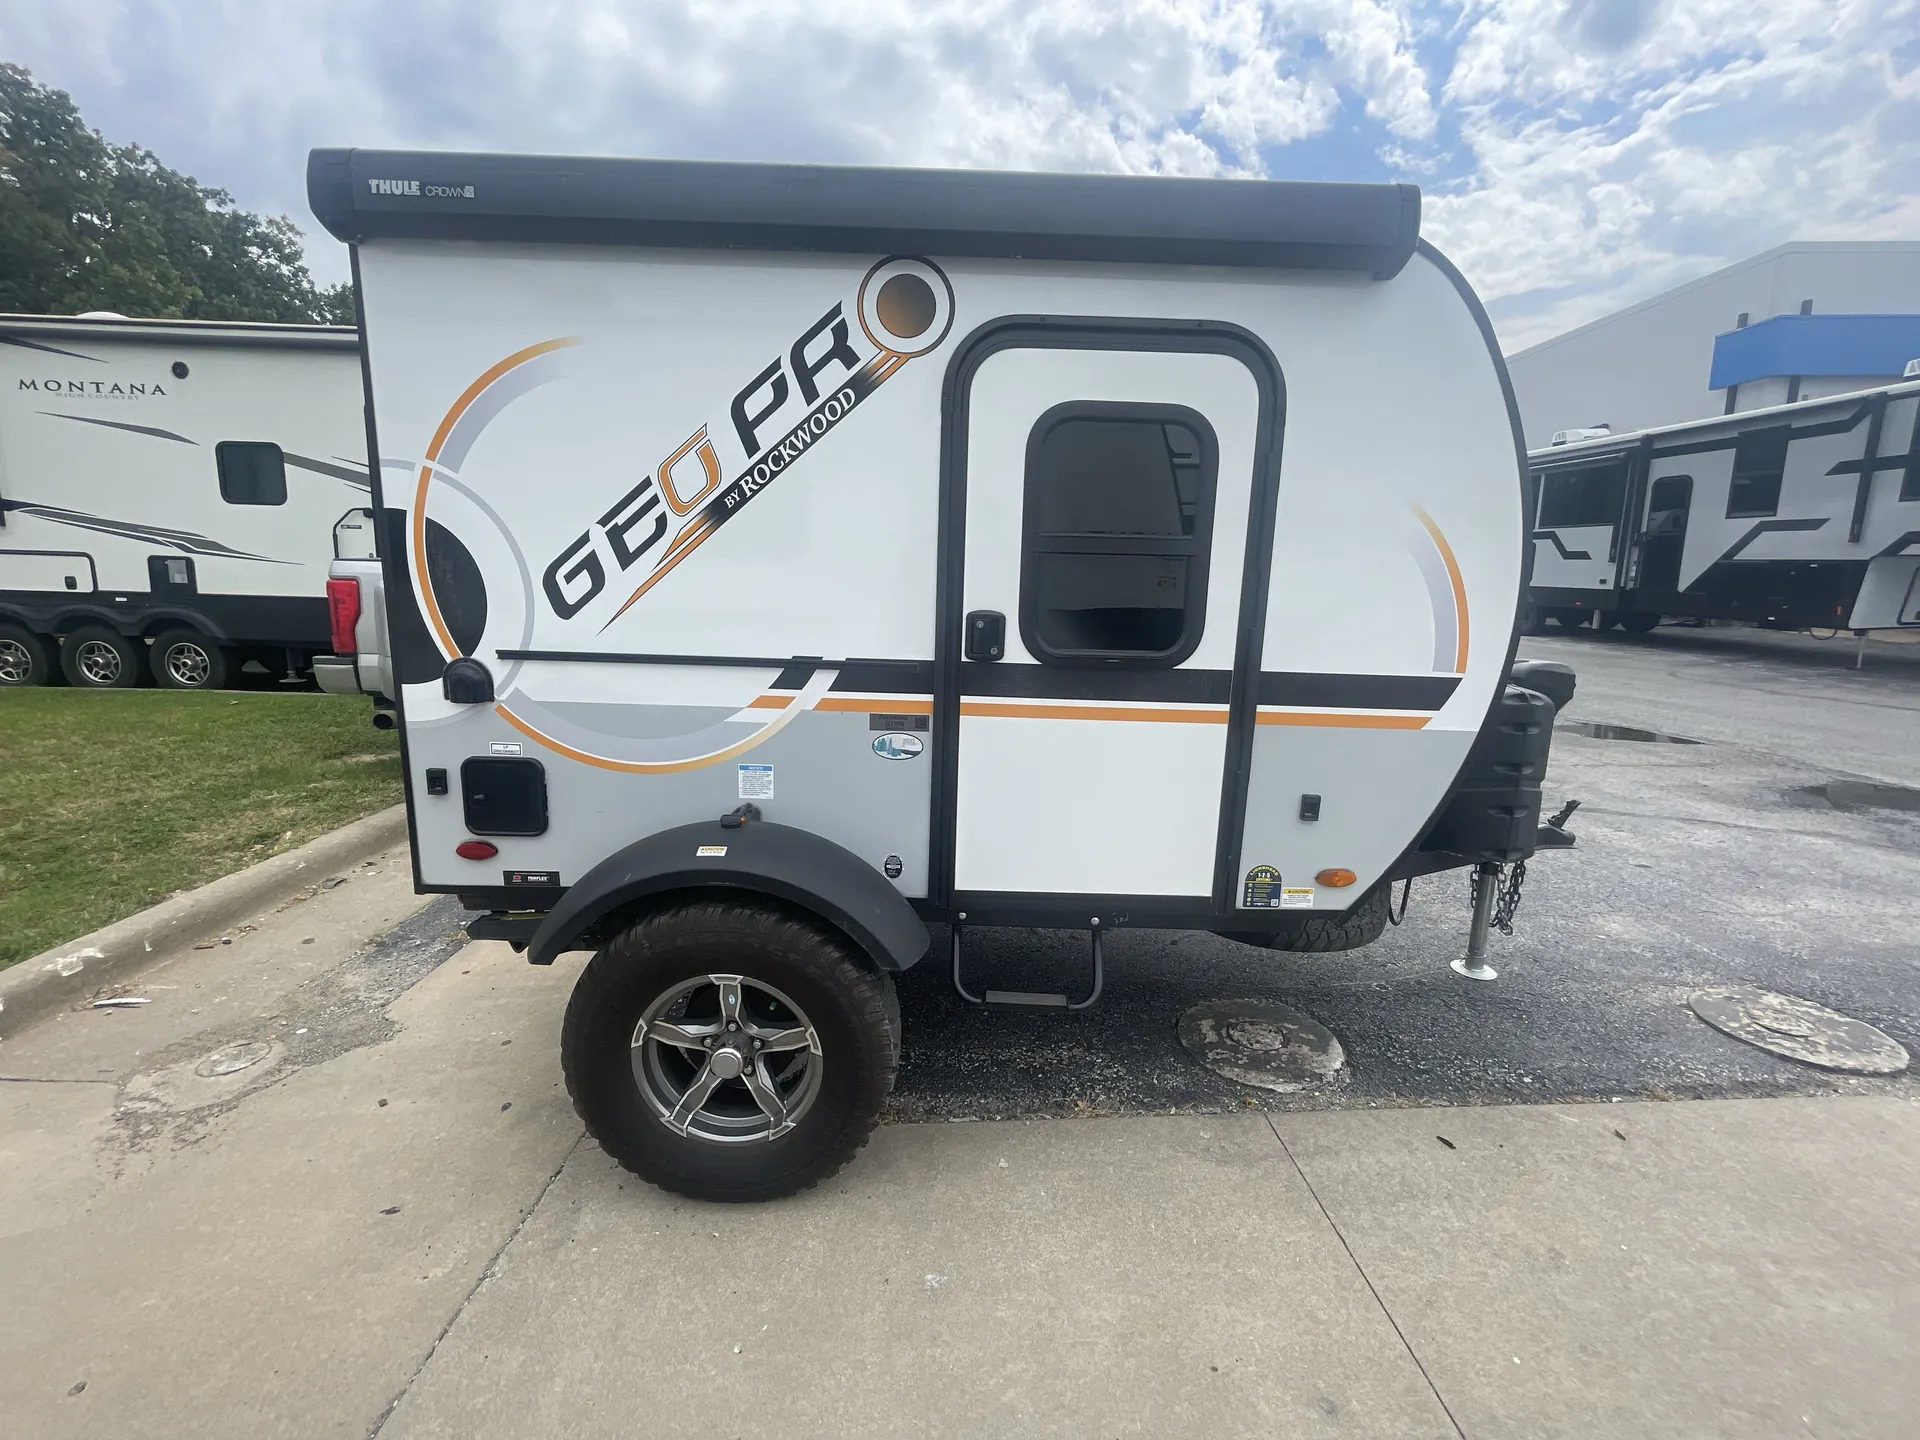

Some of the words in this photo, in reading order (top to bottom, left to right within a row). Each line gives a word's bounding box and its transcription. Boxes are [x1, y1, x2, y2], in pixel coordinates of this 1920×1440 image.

[368, 178, 420, 196] THULE
[18, 378, 168, 396] MONTANA
[88, 394, 140, 402] COUNTRY
[724, 488, 741, 509] BY
[738, 387, 856, 498] ROCKWOOD
[542, 422, 723, 621] GEO
